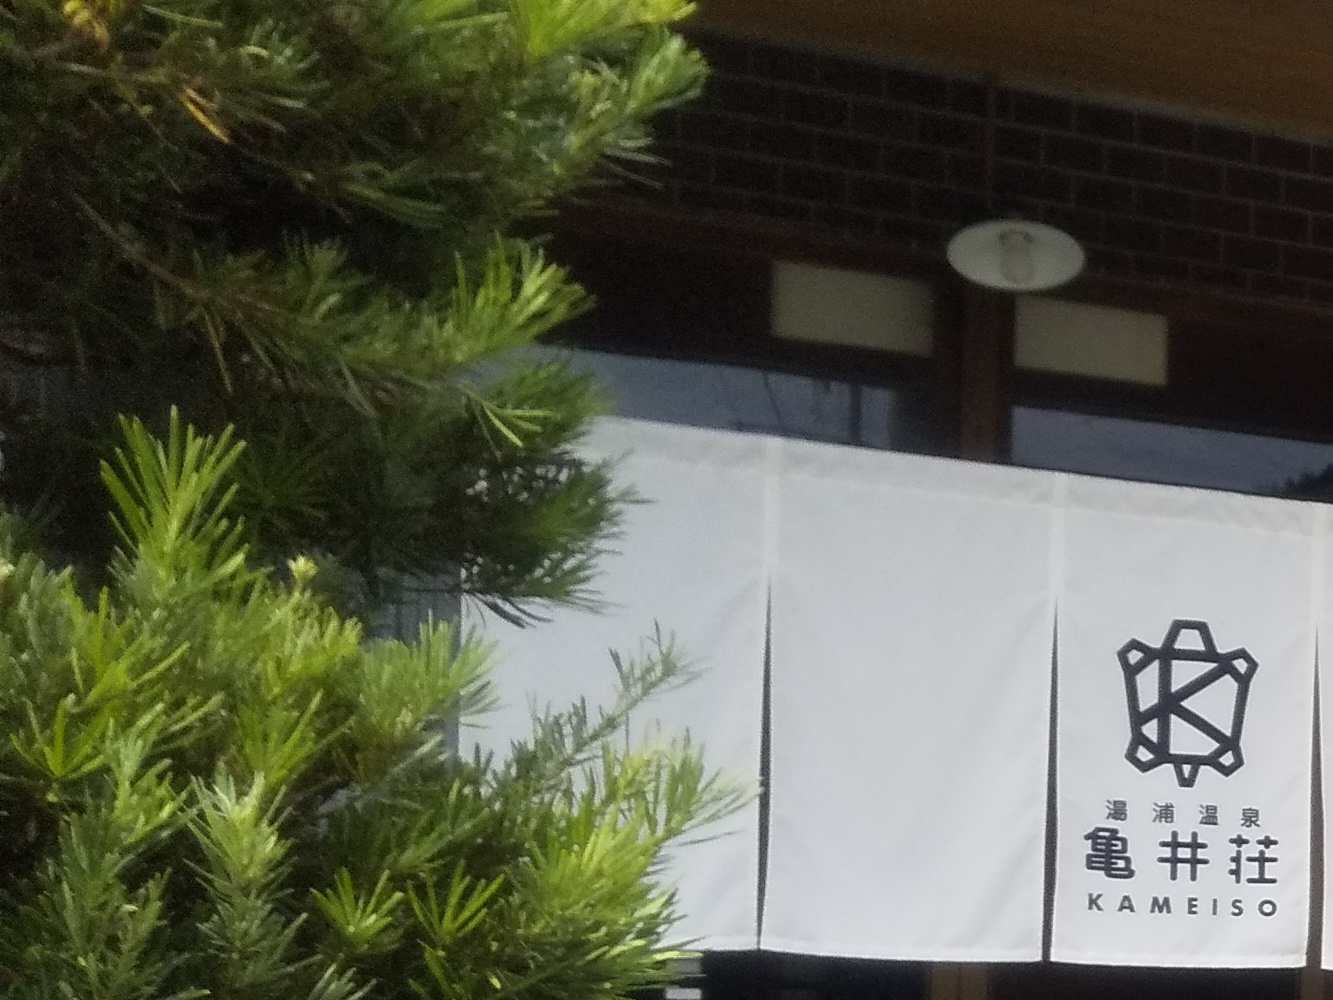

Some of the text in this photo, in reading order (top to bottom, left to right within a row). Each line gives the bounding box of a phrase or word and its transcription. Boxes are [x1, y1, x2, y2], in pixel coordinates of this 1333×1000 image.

[1104, 799, 1261, 828] 湯浦温泉
[1083, 826, 1279, 885] 亀井荘
[1087, 892, 1278, 918] KAMEISO
